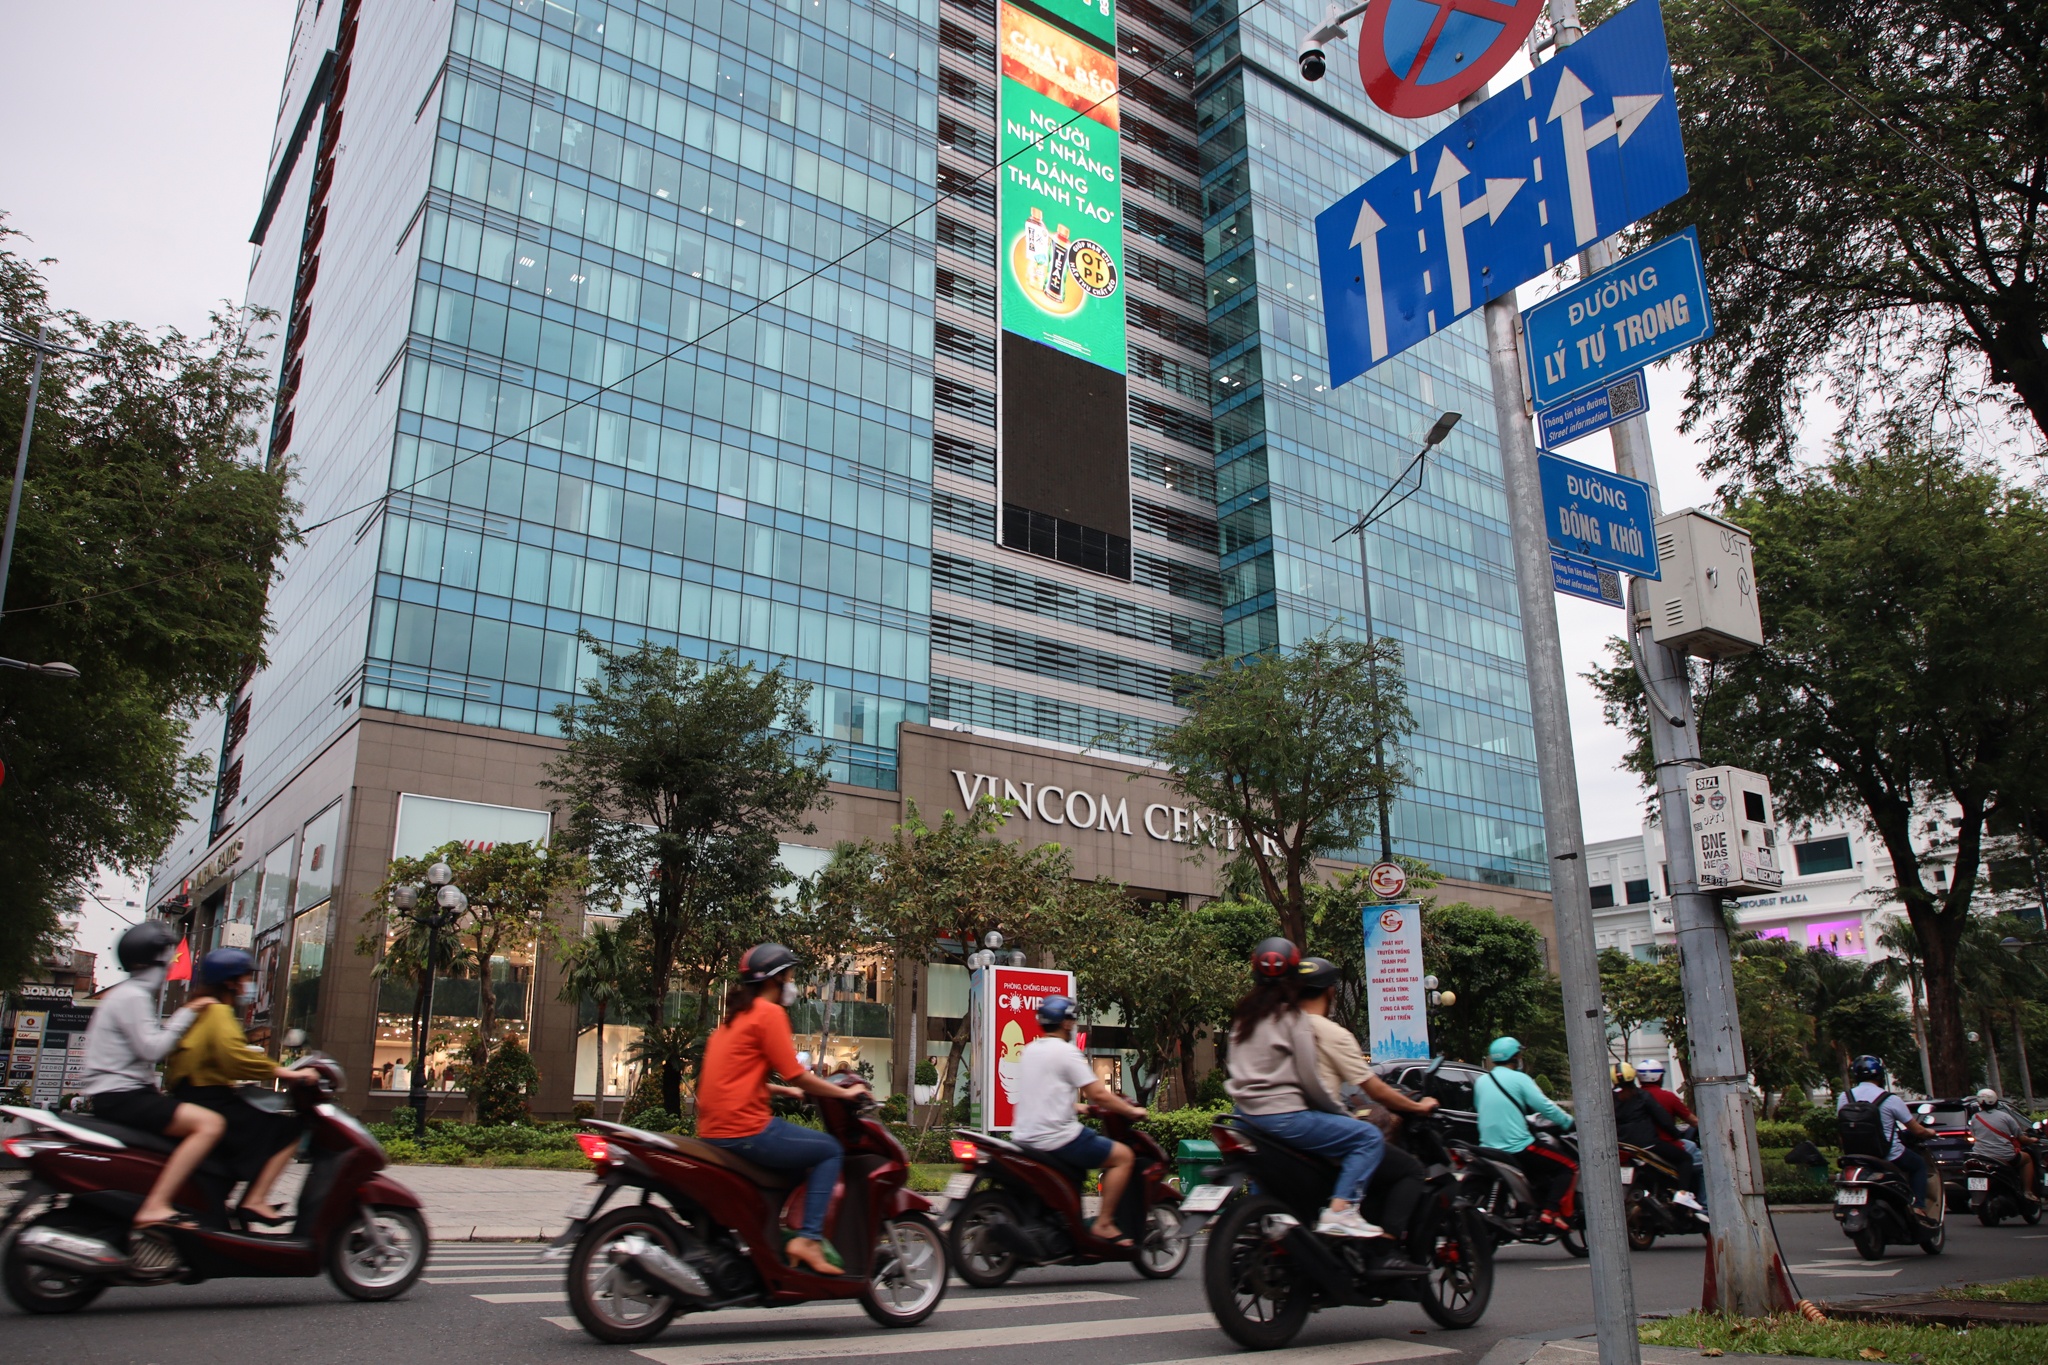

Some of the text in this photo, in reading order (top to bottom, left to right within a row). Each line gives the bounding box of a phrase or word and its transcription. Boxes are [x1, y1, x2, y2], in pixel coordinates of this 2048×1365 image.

[1030, 109, 1090, 151] NGƯỜI
[1007, 118, 1114, 182] NHẸ NHÀNG
[1008, 164, 1070, 206] THANH
[1036, 158, 1088, 194] DÁNG
[1568, 266, 1658, 326] ĐƯỜNG
[1544, 294, 1690, 386] LÝ TỰ TRỌNG
[1544, 396, 1607, 428] Thông tin tên đường
[1548, 411, 1608, 442] Street information
[1567, 474, 1628, 511] ĐƯỜNG
[1559, 502, 1644, 558] ĐỒNG KHỞI
[1556, 575, 1598, 594] Street information
[1697, 778, 1718, 790] SIZL
[952, 770, 1133, 835] VINCOM
[1701, 832, 1727, 850] BNE
[1703, 849, 1728, 860] WAS
[1704, 858, 1728, 869] HE
[1780, 894, 1808, 904] PLAZA
[1023, 983, 1040, 991] CHỐNG
